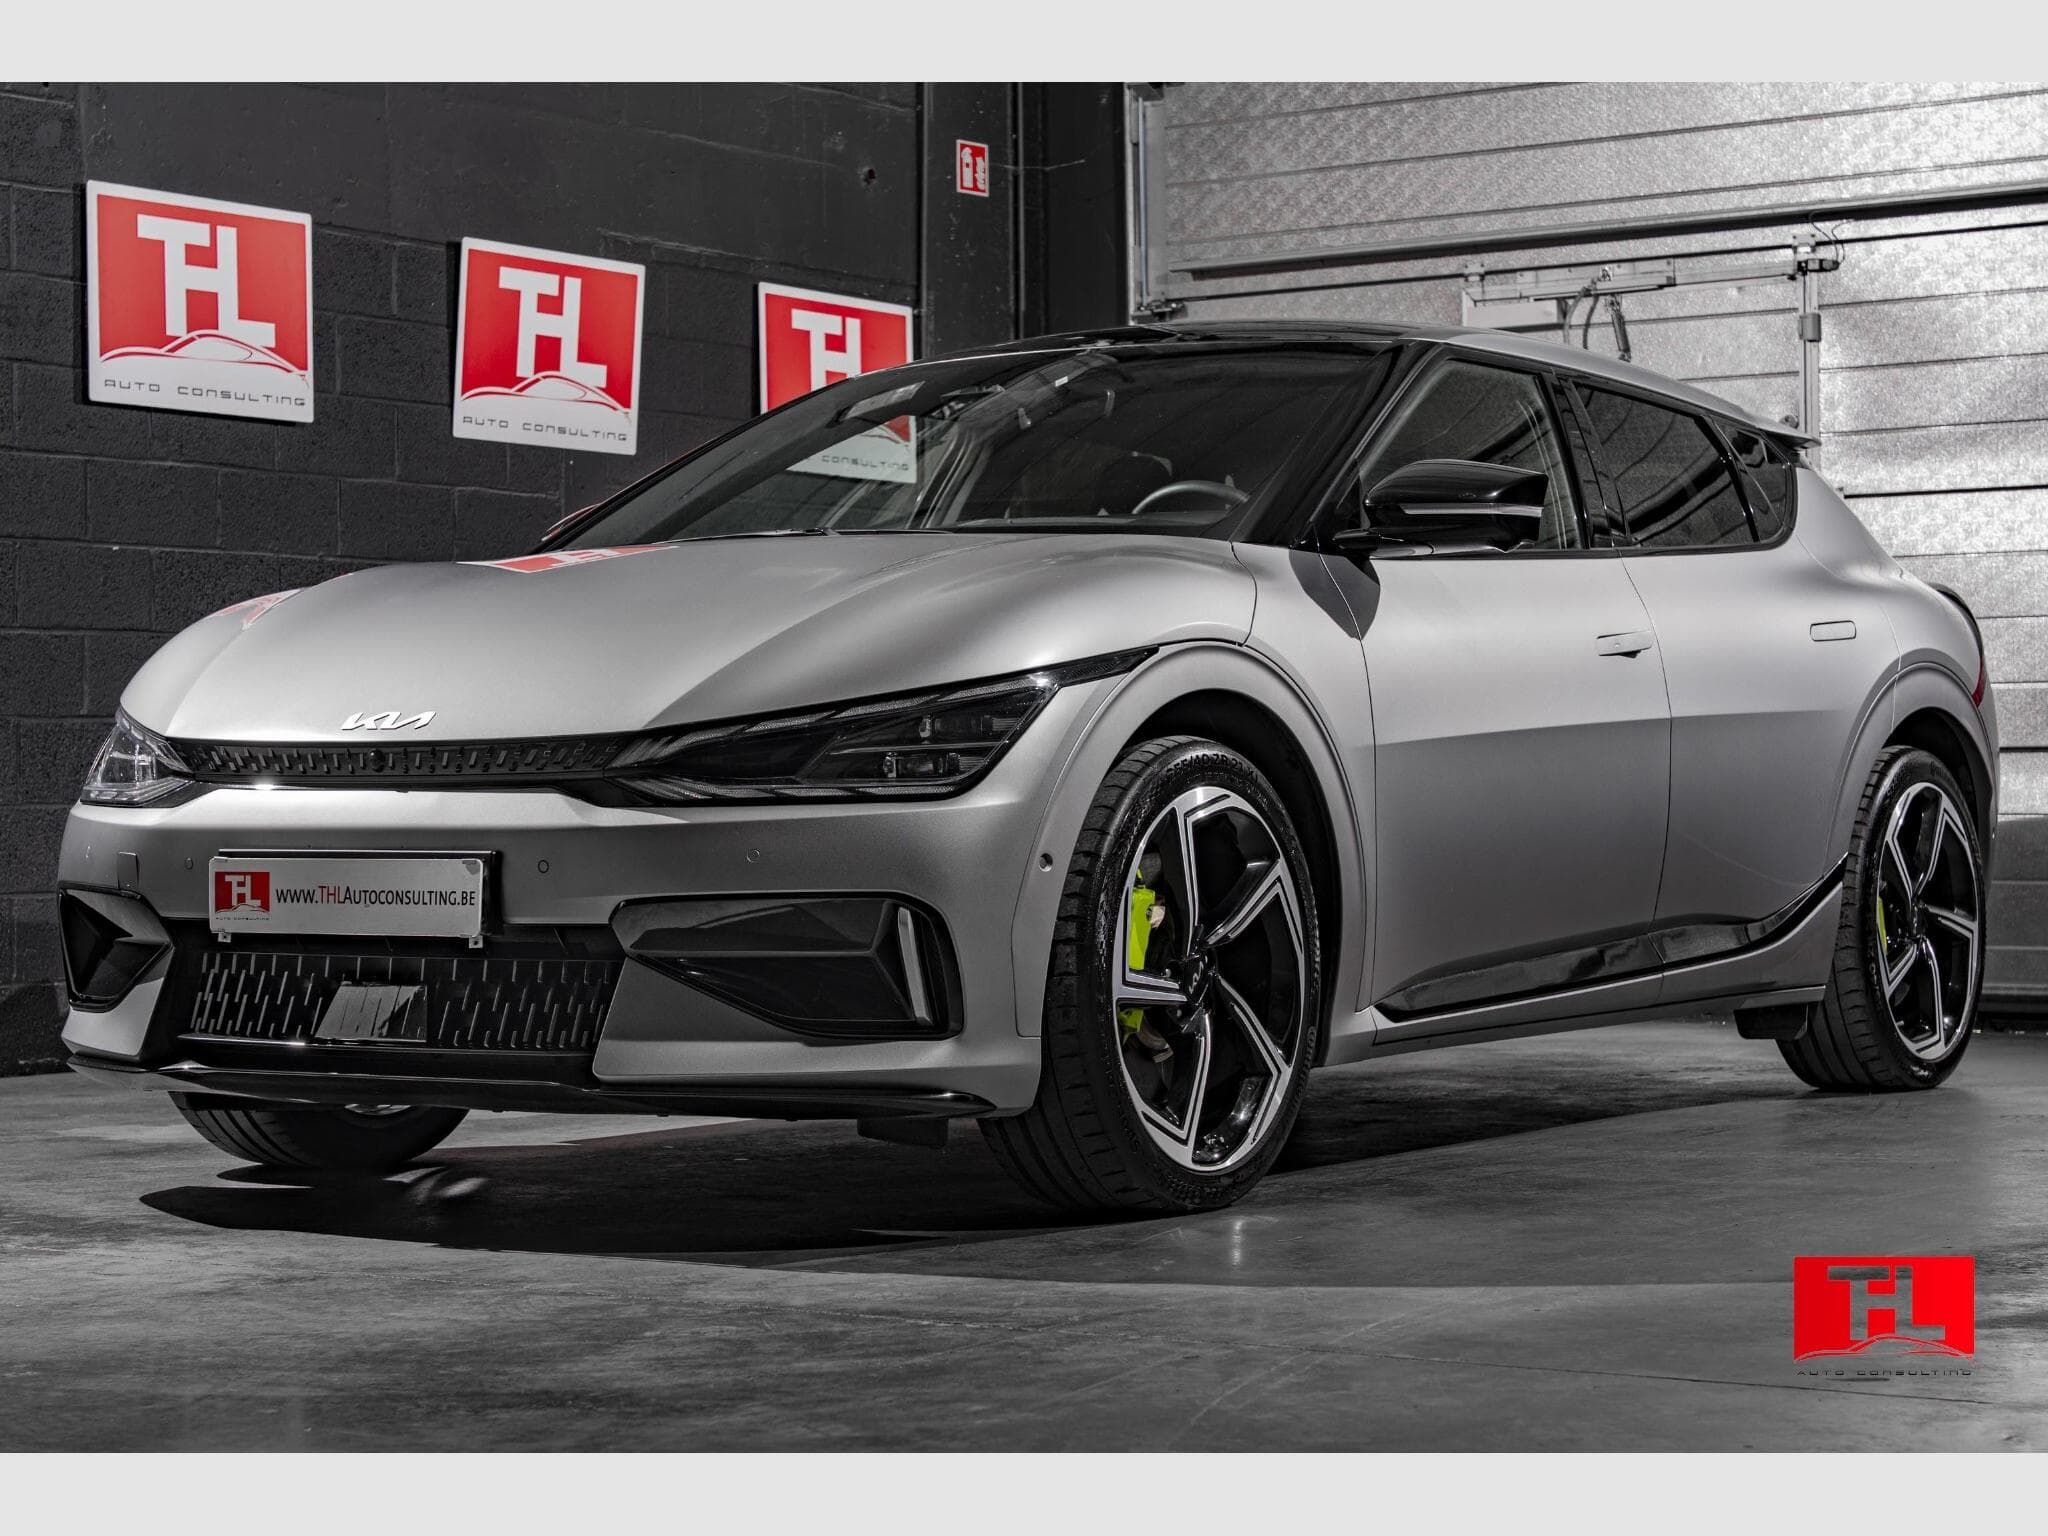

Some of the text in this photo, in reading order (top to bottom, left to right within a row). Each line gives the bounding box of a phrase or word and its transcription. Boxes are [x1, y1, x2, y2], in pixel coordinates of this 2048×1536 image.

[137, 214, 276, 348] THL
[499, 266, 608, 389] THL
[104, 379, 306, 407] AUTO CONSULTING
[462, 416, 628, 442] AUTO CONSULTING
[821, 455, 910, 472] CONSULTING
[225, 874, 262, 907] THL
